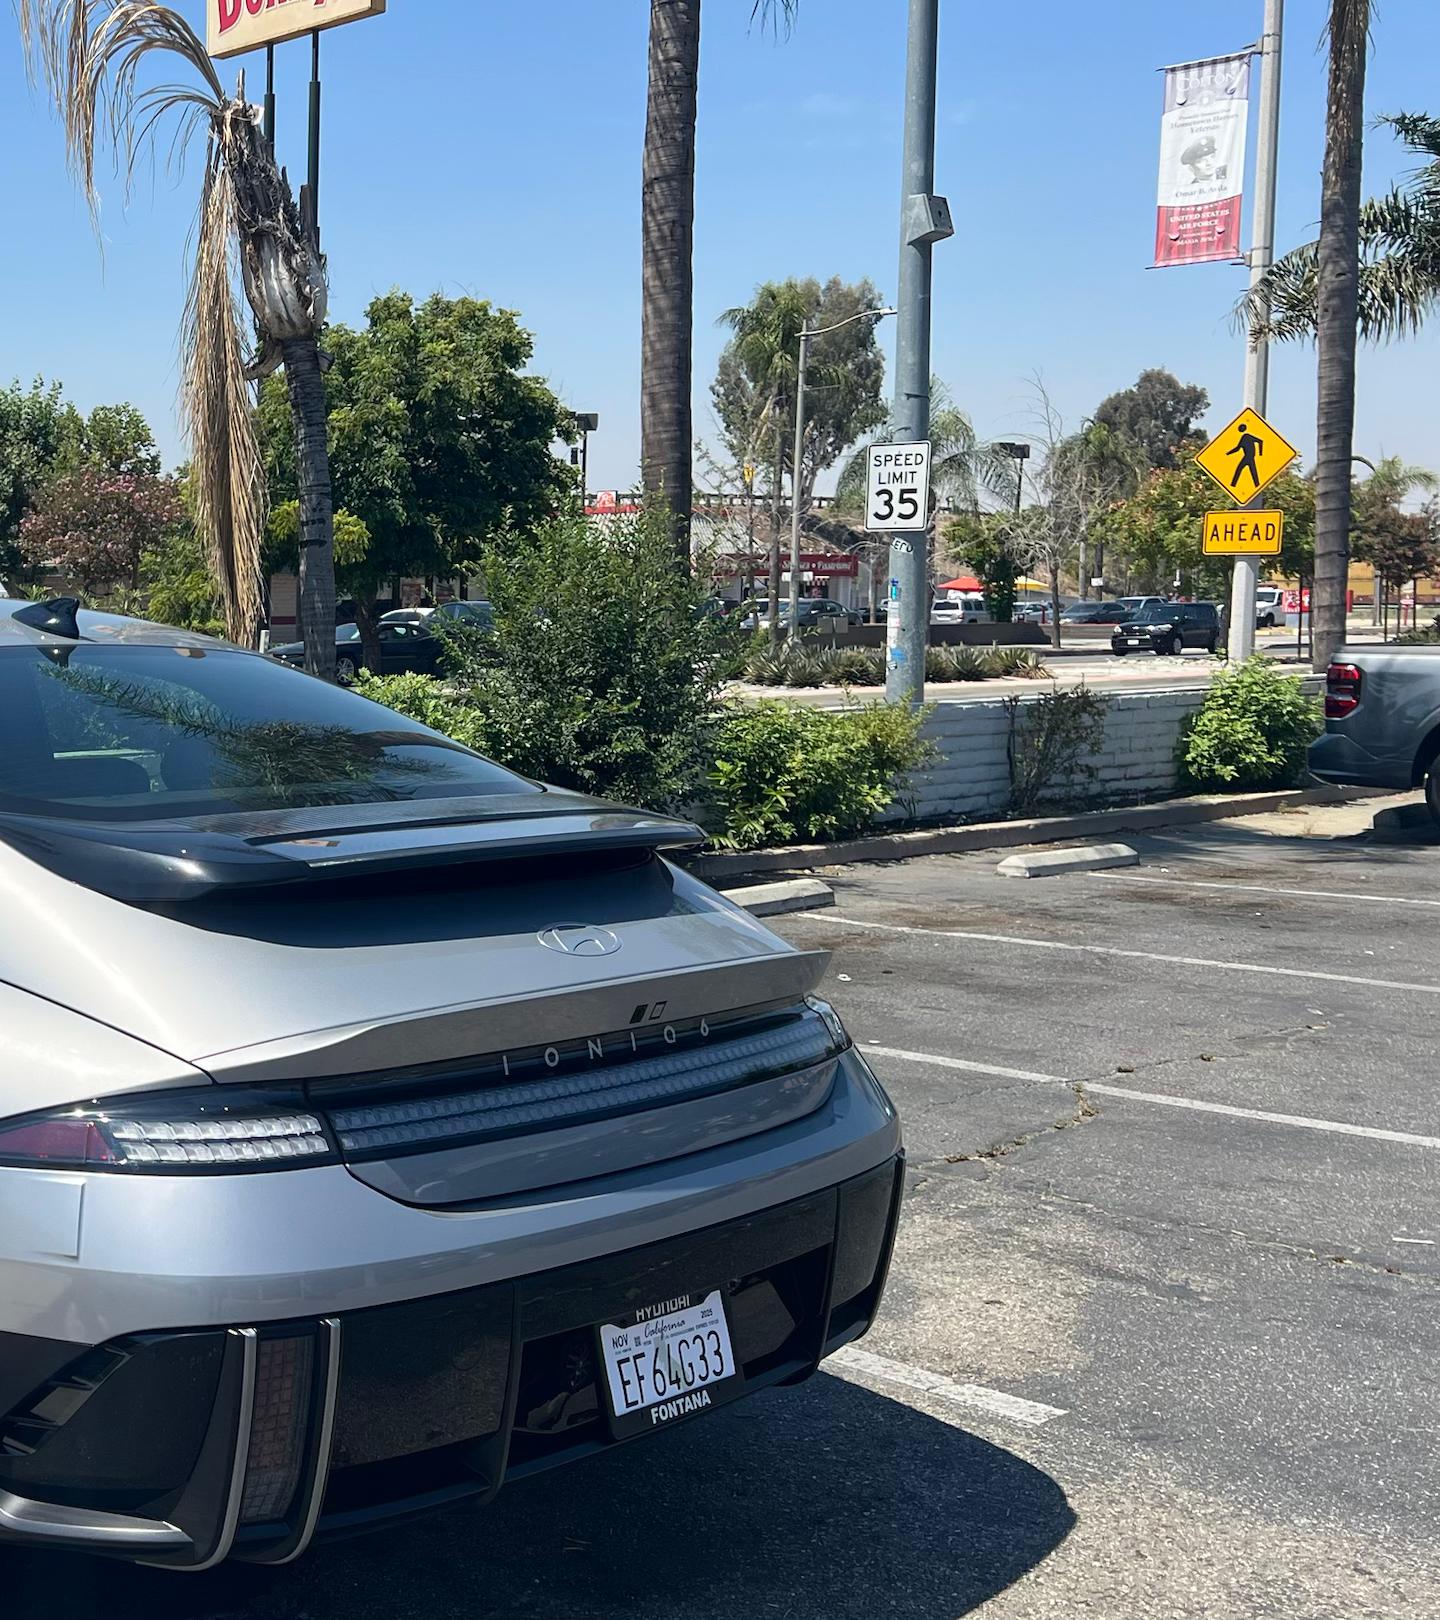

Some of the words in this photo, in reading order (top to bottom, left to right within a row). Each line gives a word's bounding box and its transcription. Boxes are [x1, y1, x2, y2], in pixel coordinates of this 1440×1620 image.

[873, 453, 924, 467] SPEED
[878, 471, 917, 485] LIMIT
[873, 488, 918, 521] 35
[1209, 522, 1276, 542] AHEAD
[502, 1025, 677, 1076] IONIQ
[700, 1018, 710, 1037] 6
[635, 1294, 690, 1322] HYUNDAI
[611, 1333, 629, 1350] NOV
[644, 1319, 687, 1341] California
[617, 1330, 724, 1409] EF64G33
[650, 1389, 712, 1425] FONTANA
